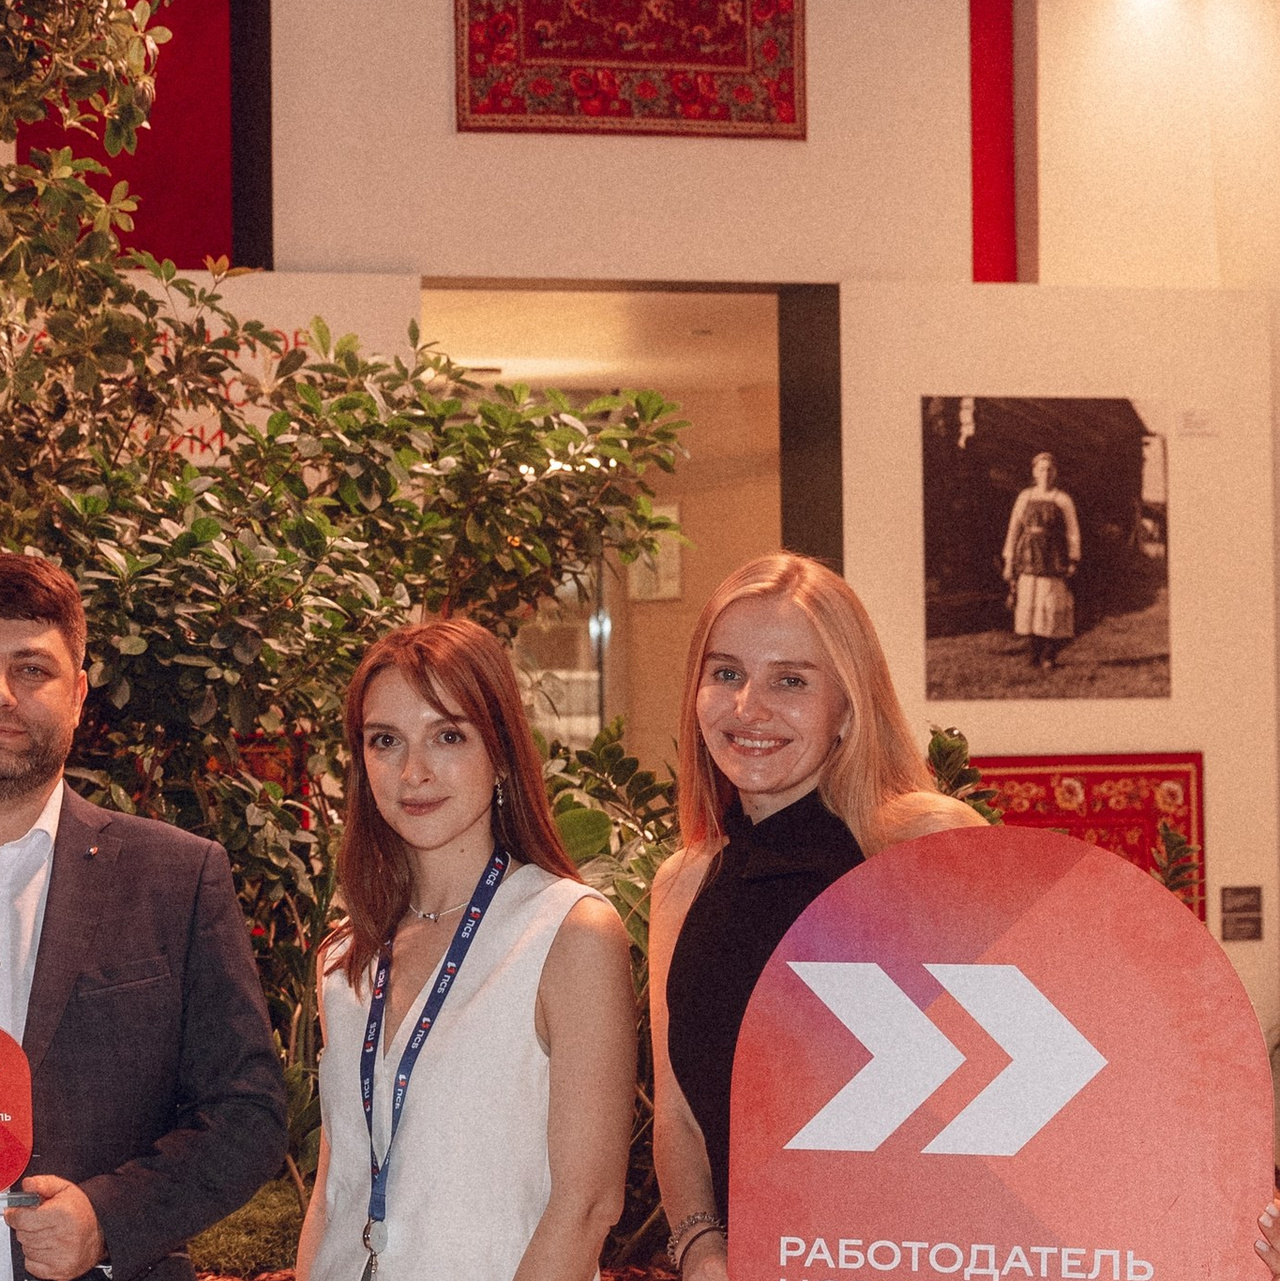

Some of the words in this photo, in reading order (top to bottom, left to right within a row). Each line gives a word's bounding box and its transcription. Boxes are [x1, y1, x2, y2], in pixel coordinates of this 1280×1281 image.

[486, 867, 500, 887] ПСБ
[461, 918, 476, 938] ПСБ
[437, 974, 451, 994] ПСБ
[368, 1022, 377, 1041] ПСБ
[412, 1029, 425, 1048] ПСБ
